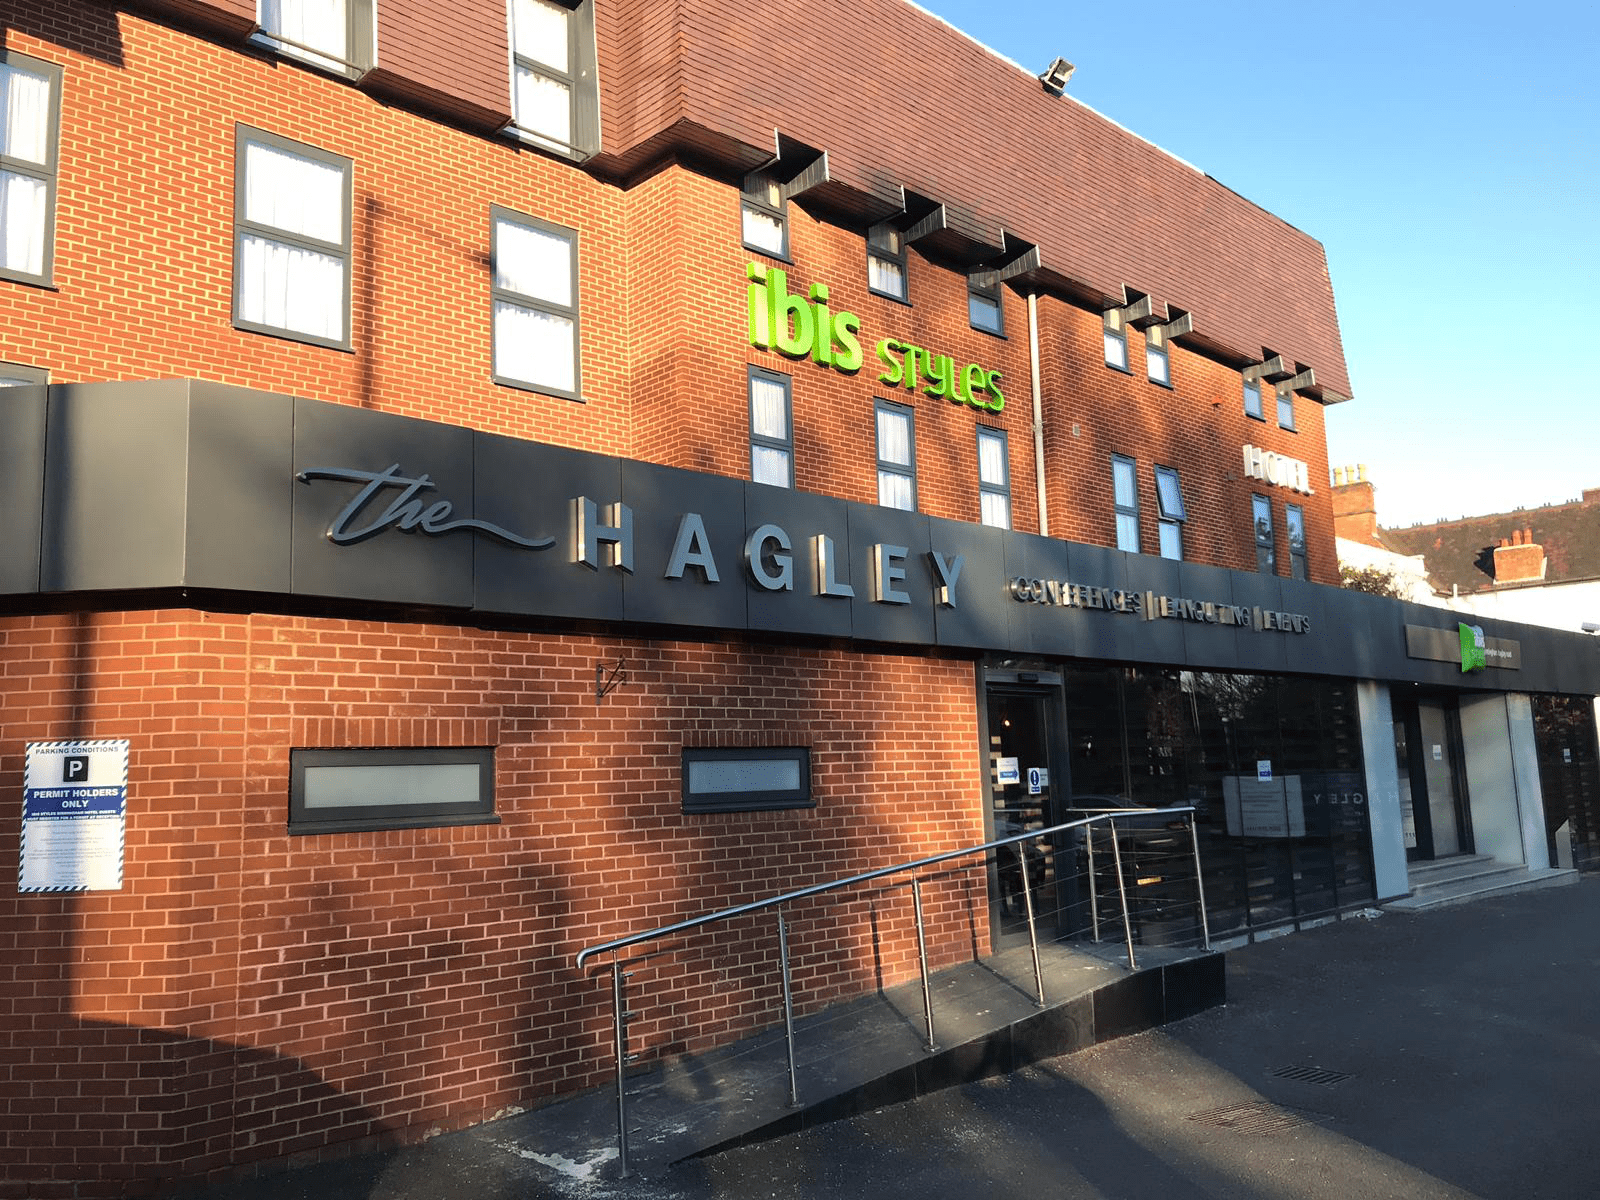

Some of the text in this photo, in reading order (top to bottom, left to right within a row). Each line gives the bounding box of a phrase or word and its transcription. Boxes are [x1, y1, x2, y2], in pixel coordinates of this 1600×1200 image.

[746, 261, 864, 375] ibis
[575, 496, 965, 610] HAGLEY
[1010, 576, 1141, 613] CONFERENCES
[1263, 610, 1311, 634] EVENTS
[69, 760, 83, 778] P
[33, 788, 119, 799] PERMIT HOLDERS
[61, 800, 89, 808] ONLY
